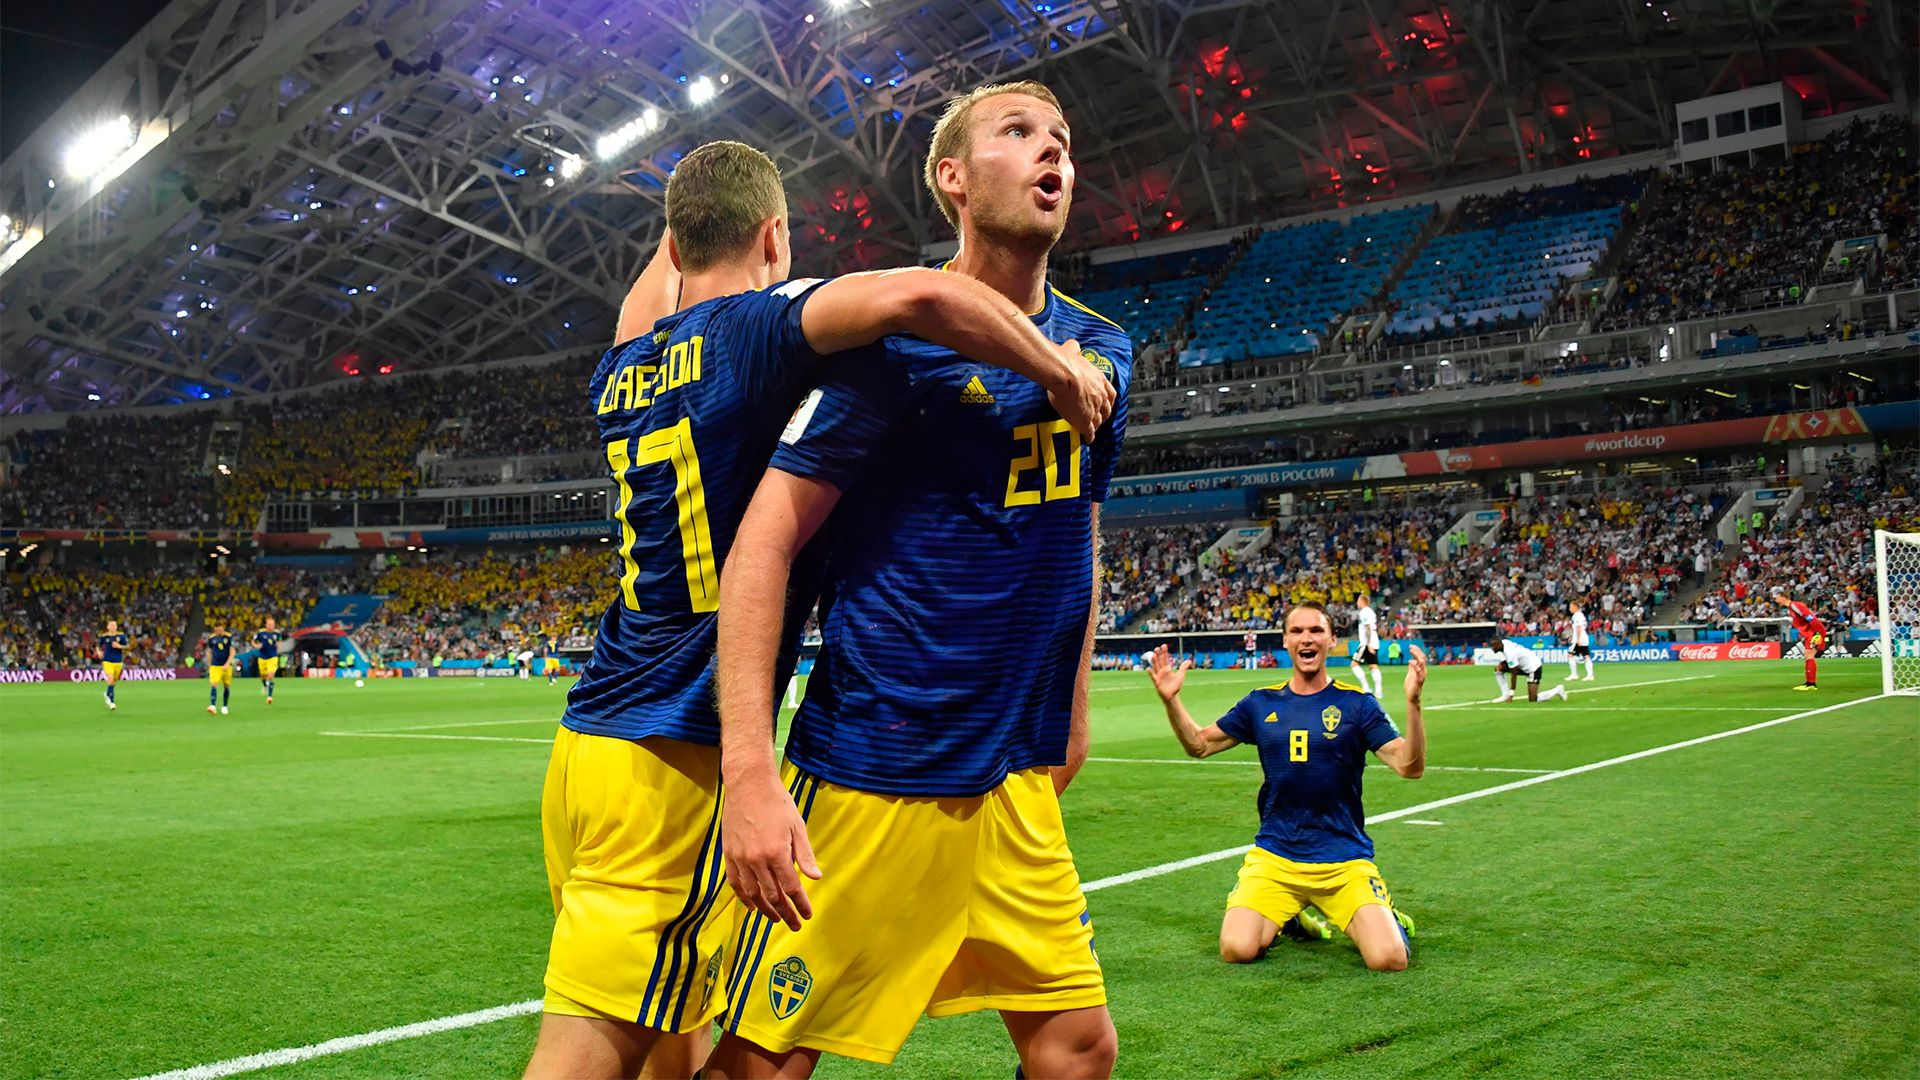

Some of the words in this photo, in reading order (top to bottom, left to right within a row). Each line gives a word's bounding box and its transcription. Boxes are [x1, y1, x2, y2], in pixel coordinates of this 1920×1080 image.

[959, 394, 994, 404] adidas
[1584, 435, 1665, 452] #worldcup
[1004, 418, 1081, 508] 20
[1241, 472, 1268, 486] 2018
[1271, 472, 1279, 483] В
[1282, 467, 1335, 482] РОССИИ
[607, 416, 719, 613] 17
[530, 529, 560, 539] WORLD
[561, 528, 578, 537] CUP
[1536, 649, 1568, 663] PROM
[1619, 648, 1669, 661] WANDA
[1679, 645, 1718, 659] Coca-Cola
[1728, 644, 1768, 659] Coca-Cola
[70, 669, 107, 682] QATA
[120, 668, 176, 681] AIRWAYS
[1289, 729, 1308, 762] 8
[779, 971, 804, 984] SVERIGE
